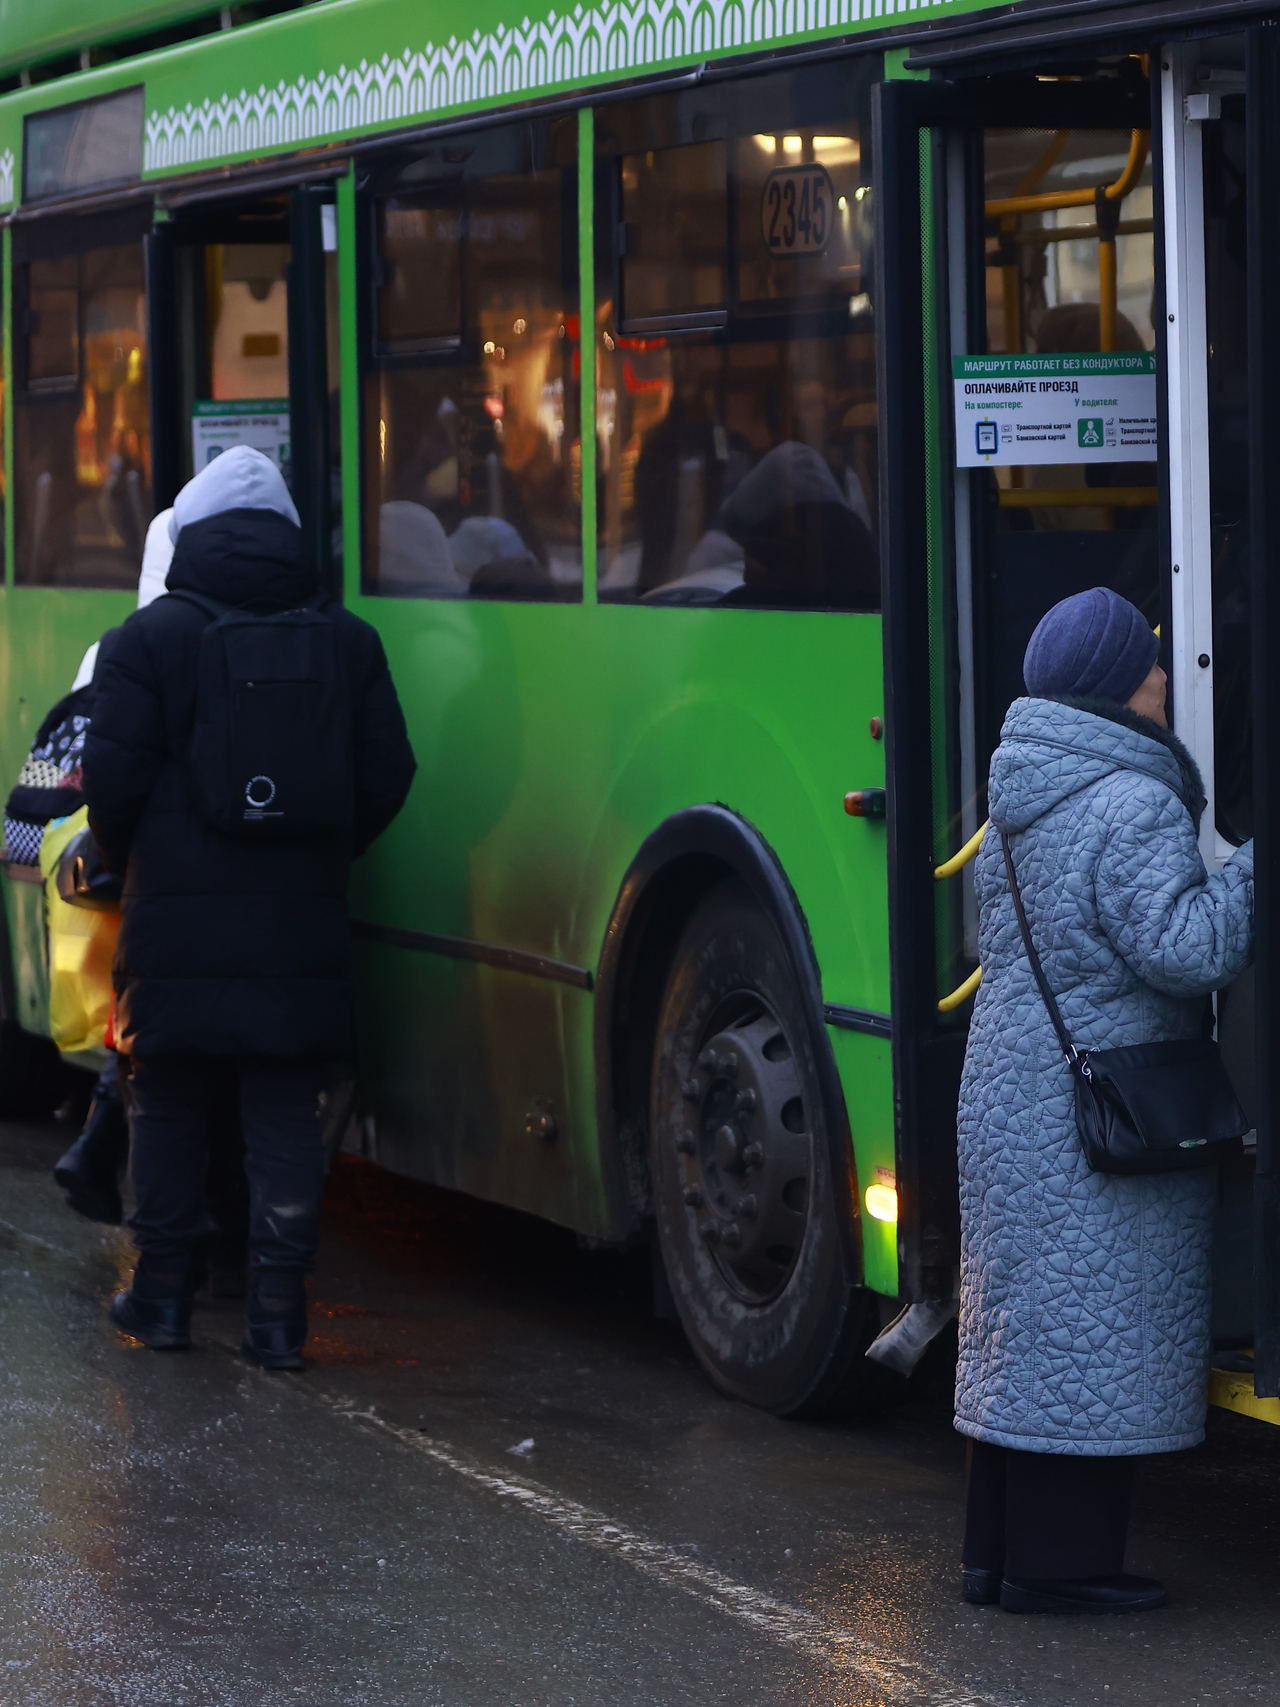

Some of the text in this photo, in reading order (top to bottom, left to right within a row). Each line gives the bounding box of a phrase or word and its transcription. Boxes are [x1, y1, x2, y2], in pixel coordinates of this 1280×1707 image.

[768, 176, 826, 248] 2345
[964, 357, 1143, 371] МАРШРУТ РАБОТАЕТ БЕЗ КОНДУКТОРА
[964, 380, 1079, 394] ОПЛАЧИВАЙТЕ ПРОЕЗД
[965, 401, 1023, 410] На компостере:
[1074, 398, 1119, 407] У водителя:
